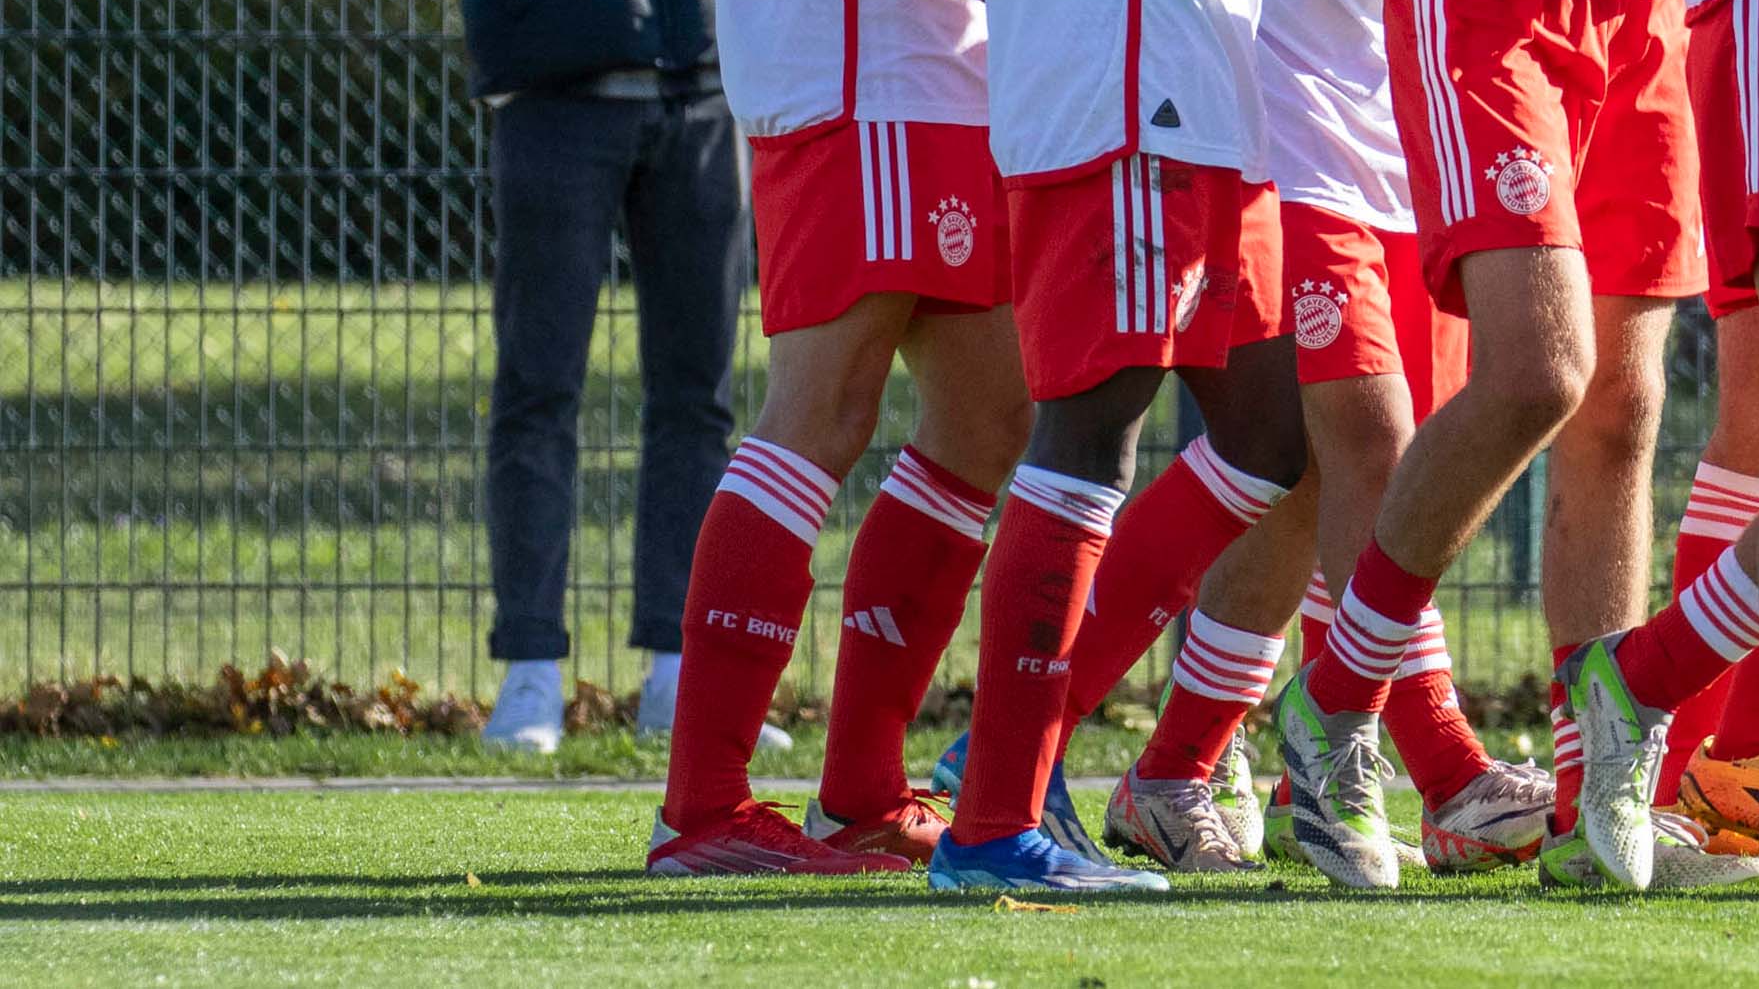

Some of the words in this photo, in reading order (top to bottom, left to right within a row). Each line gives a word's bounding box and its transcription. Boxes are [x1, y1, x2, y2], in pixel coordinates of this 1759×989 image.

[706, 609, 738, 628] FC
[746, 617, 797, 646] BAYE
[1016, 656, 1043, 674] FC
